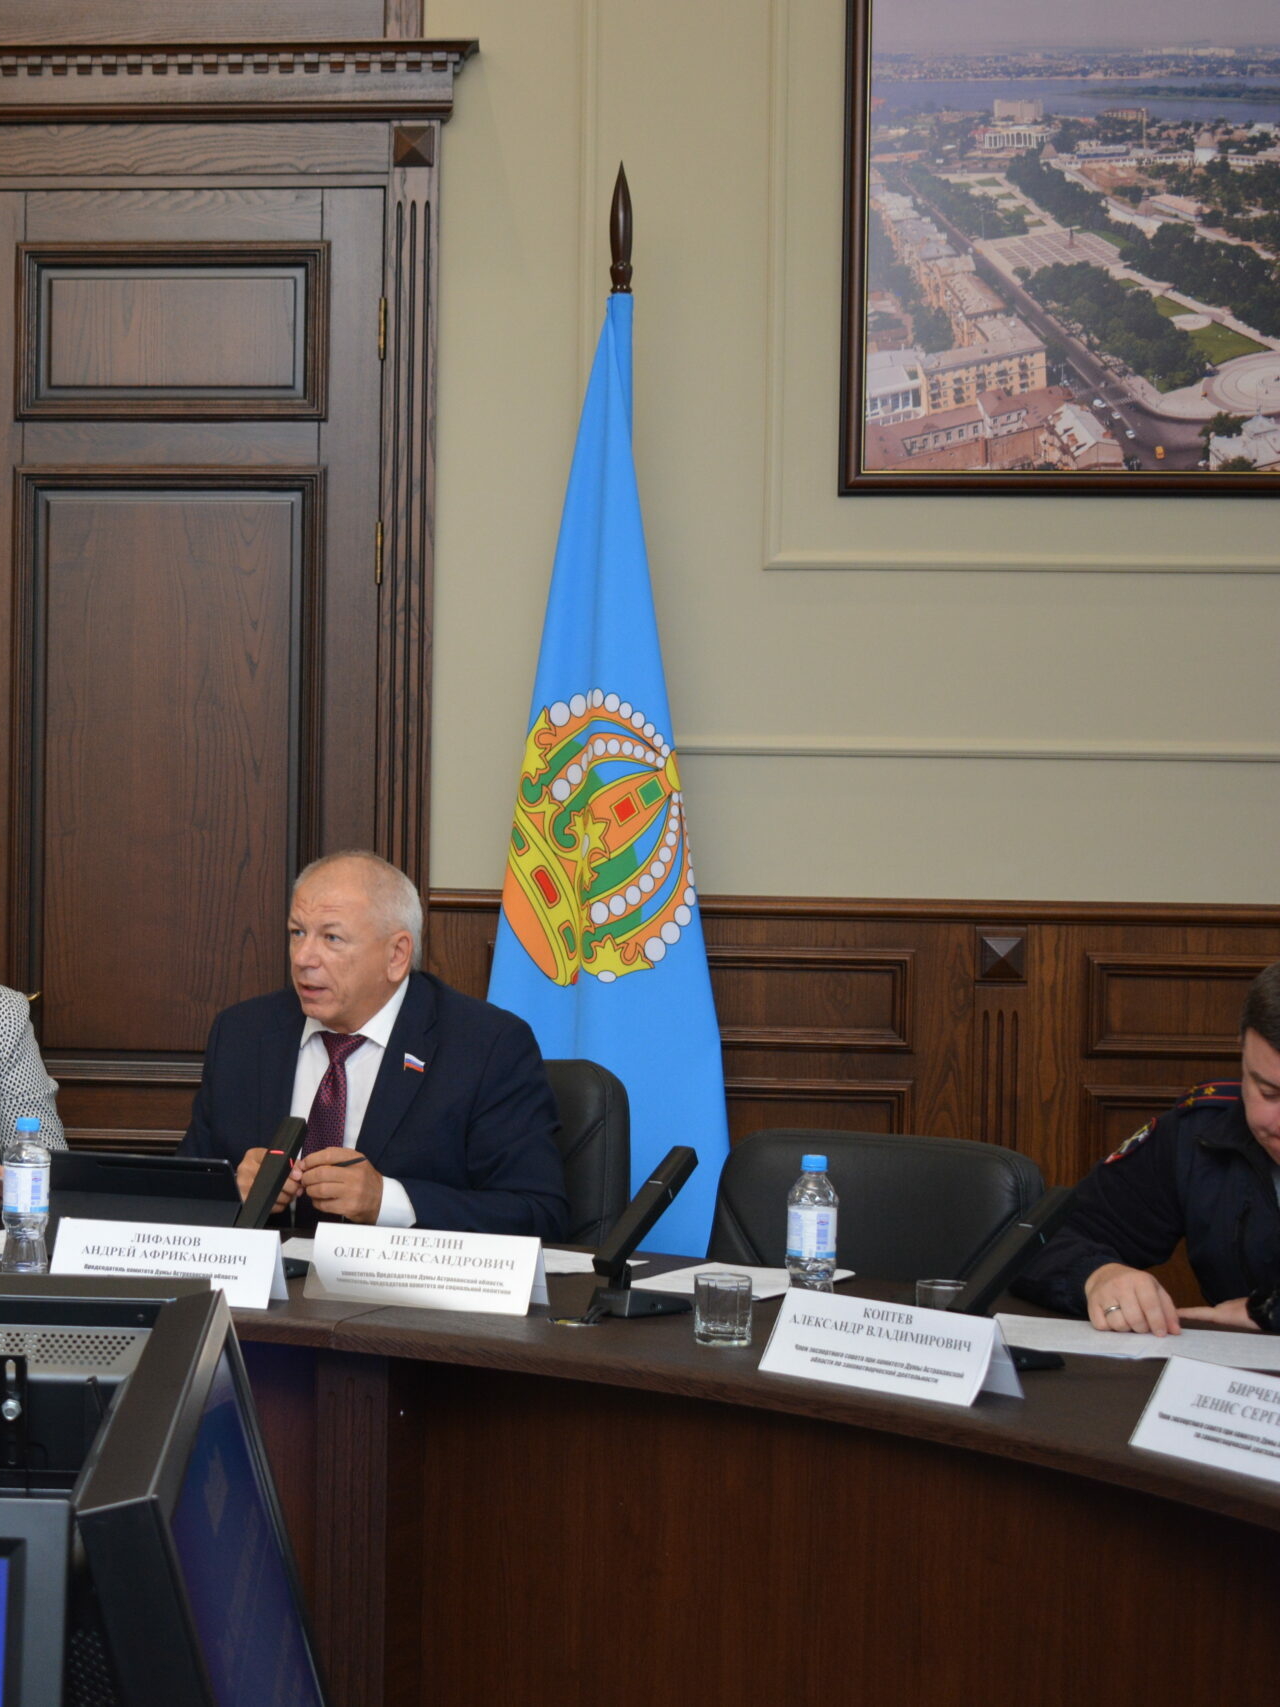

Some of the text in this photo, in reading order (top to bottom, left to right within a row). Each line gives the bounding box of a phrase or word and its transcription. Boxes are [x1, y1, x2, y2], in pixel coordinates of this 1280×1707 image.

[131, 1233, 201, 1247] ЛИФАНОВ
[390, 1235, 464, 1250] ПЕТЕЛИН
[82, 1245, 247, 1266] АНДРЕЙ АФРИКАНОВИЧ
[334, 1246, 516, 1271] ОЛЕГ АЛЕКСАНДРОВИЧ
[863, 1307, 913, 1325] КОПТЕВ
[789, 1314, 972, 1352] АЛЕКСАНДР ВЛАДИМИРОВИЧ
[1190, 1394, 1240, 1415] ДЕНИС
